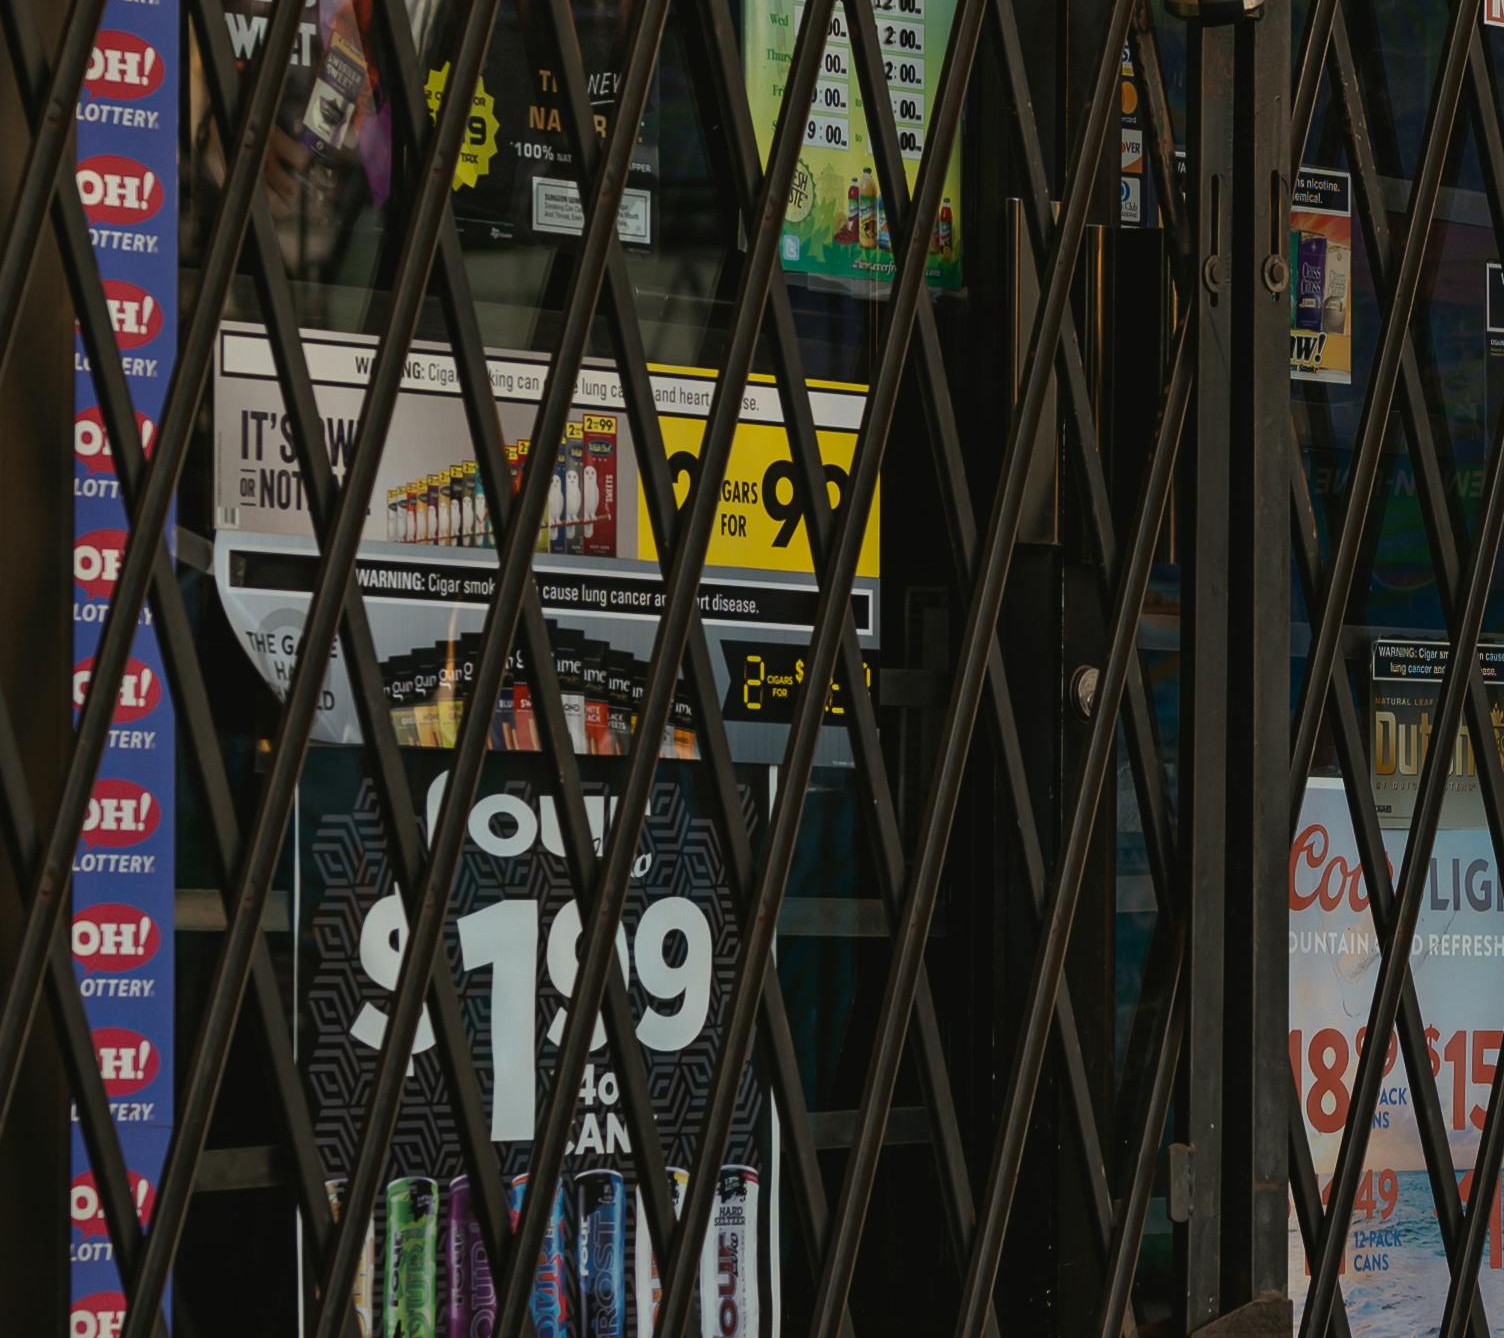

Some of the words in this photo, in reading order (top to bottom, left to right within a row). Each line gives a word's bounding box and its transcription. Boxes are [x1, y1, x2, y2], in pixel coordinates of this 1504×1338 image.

[769, 12, 789, 28] Wed
[85, 47, 156, 86] OH!
[76, 103, 159, 129] LOTTERY
[515, 142, 556, 161] 100%
[76, 170, 155, 210] OH!
[1306, 178, 1341, 193] nicotine.
[89, 230, 158, 253] OTTERY
[517, 374, 540, 391] can
[581, 376, 607, 400] lung
[654, 384, 676, 402] and
[678, 387, 710, 407] heart
[241, 410, 295, 463] IT'S
[240, 477, 255, 498] OR
[721, 479, 758, 505] GARS
[720, 515, 747, 538] FOR
[355, 568, 426, 591] WARNING:
[427, 573, 460, 594] Cigar
[542, 585, 579, 602] cause
[581, 584, 607, 608] lung
[610, 591, 652, 607] cancer
[711, 598, 760, 615] disease.
[247, 631, 277, 655] THE
[1378, 646, 1417, 659] WARNING:
[1418, 649, 1438, 661] Cigar
[1389, 663, 1407, 676] lung
[1408, 664, 1432, 675] cancer
[771, 688, 788, 698] FOR
[1375, 696, 1412, 706] NATURAL
[82, 793, 151, 832] OH!
[71, 854, 155, 873] LOTTERY
[71, 916, 151, 956] OH!
[80, 979, 155, 997] OTTERY
[1354, 1253, 1390, 1271] CANS
